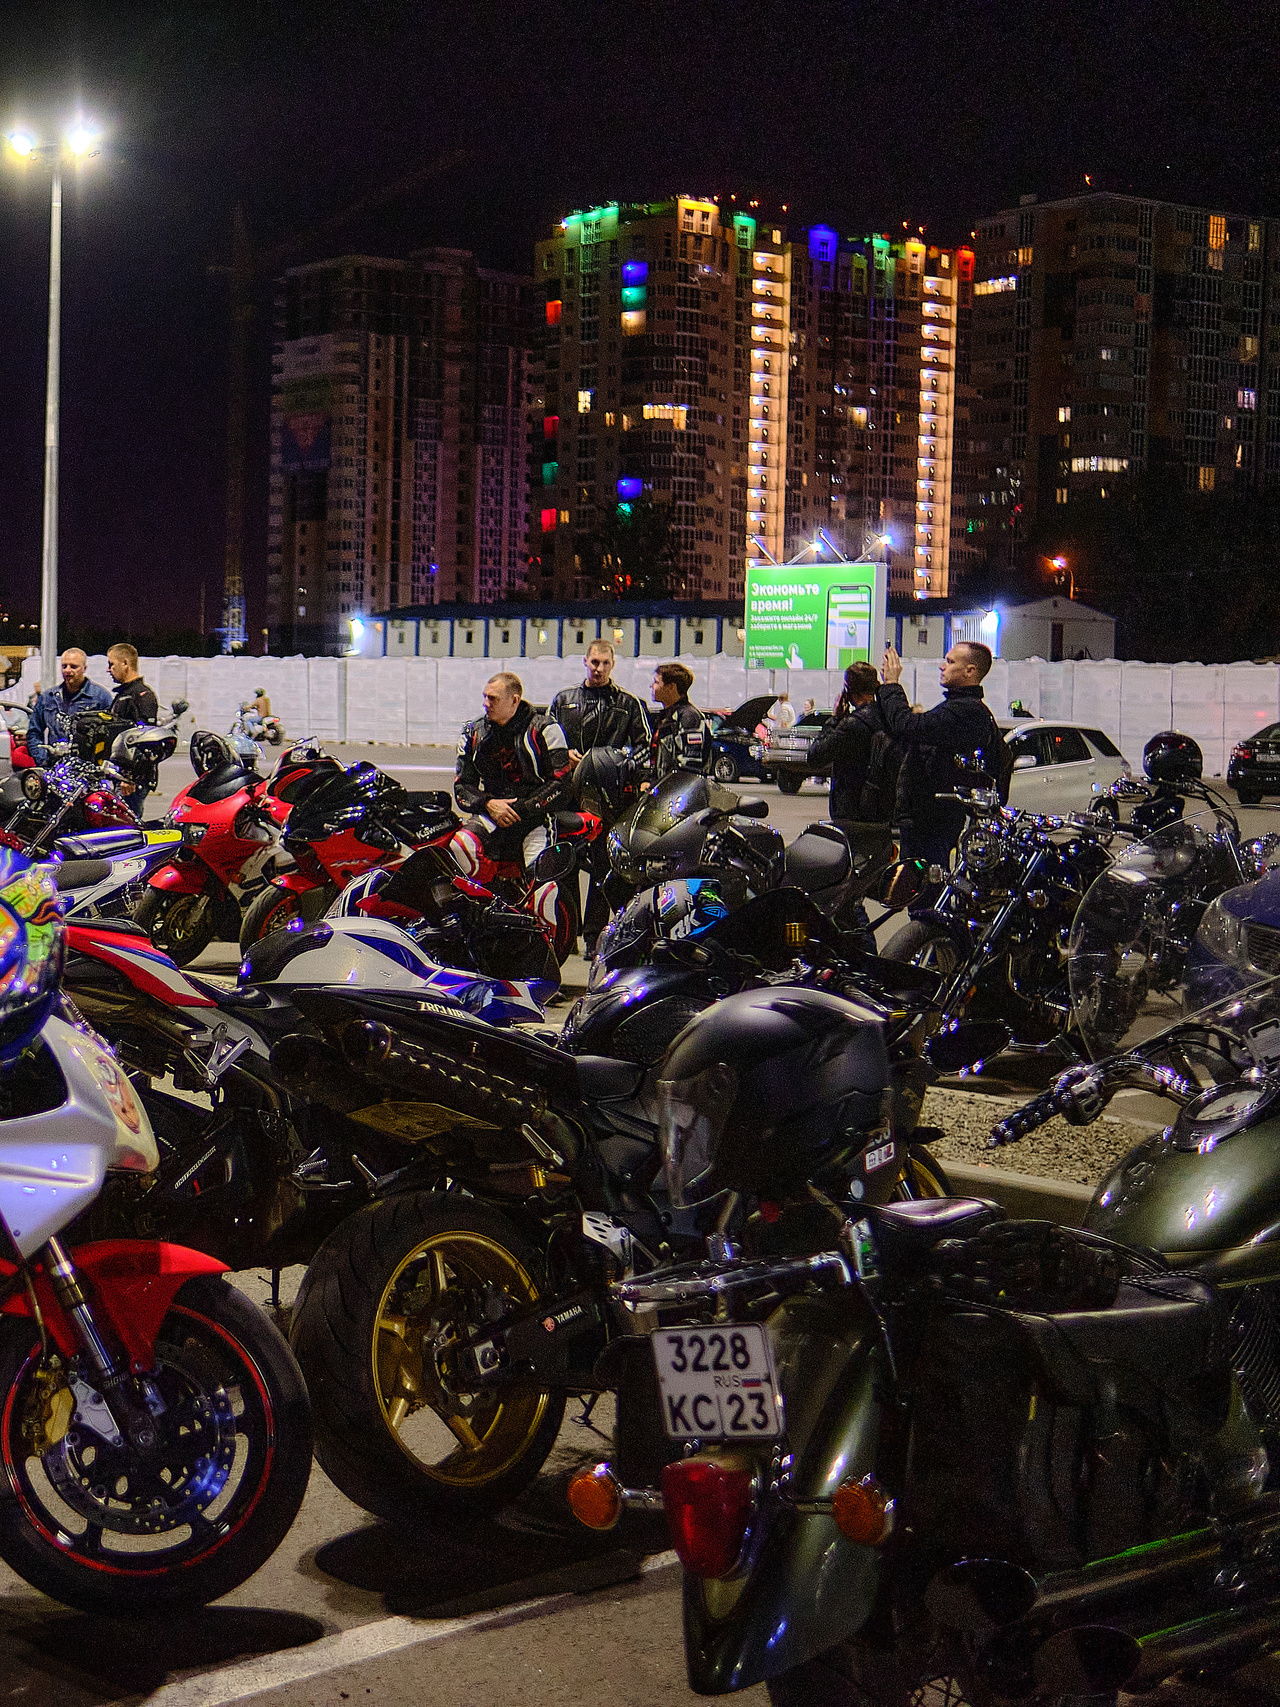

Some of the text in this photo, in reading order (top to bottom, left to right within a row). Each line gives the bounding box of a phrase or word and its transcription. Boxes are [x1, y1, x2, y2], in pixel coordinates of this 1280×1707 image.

[751, 582, 820, 596] Экономьте
[750, 597, 793, 614] время!
[554, 1304, 584, 1324] YAMAHA
[667, 1332, 751, 1373] 3228
[713, 1374, 742, 1388] RUS
[726, 1392, 769, 1431] 23
